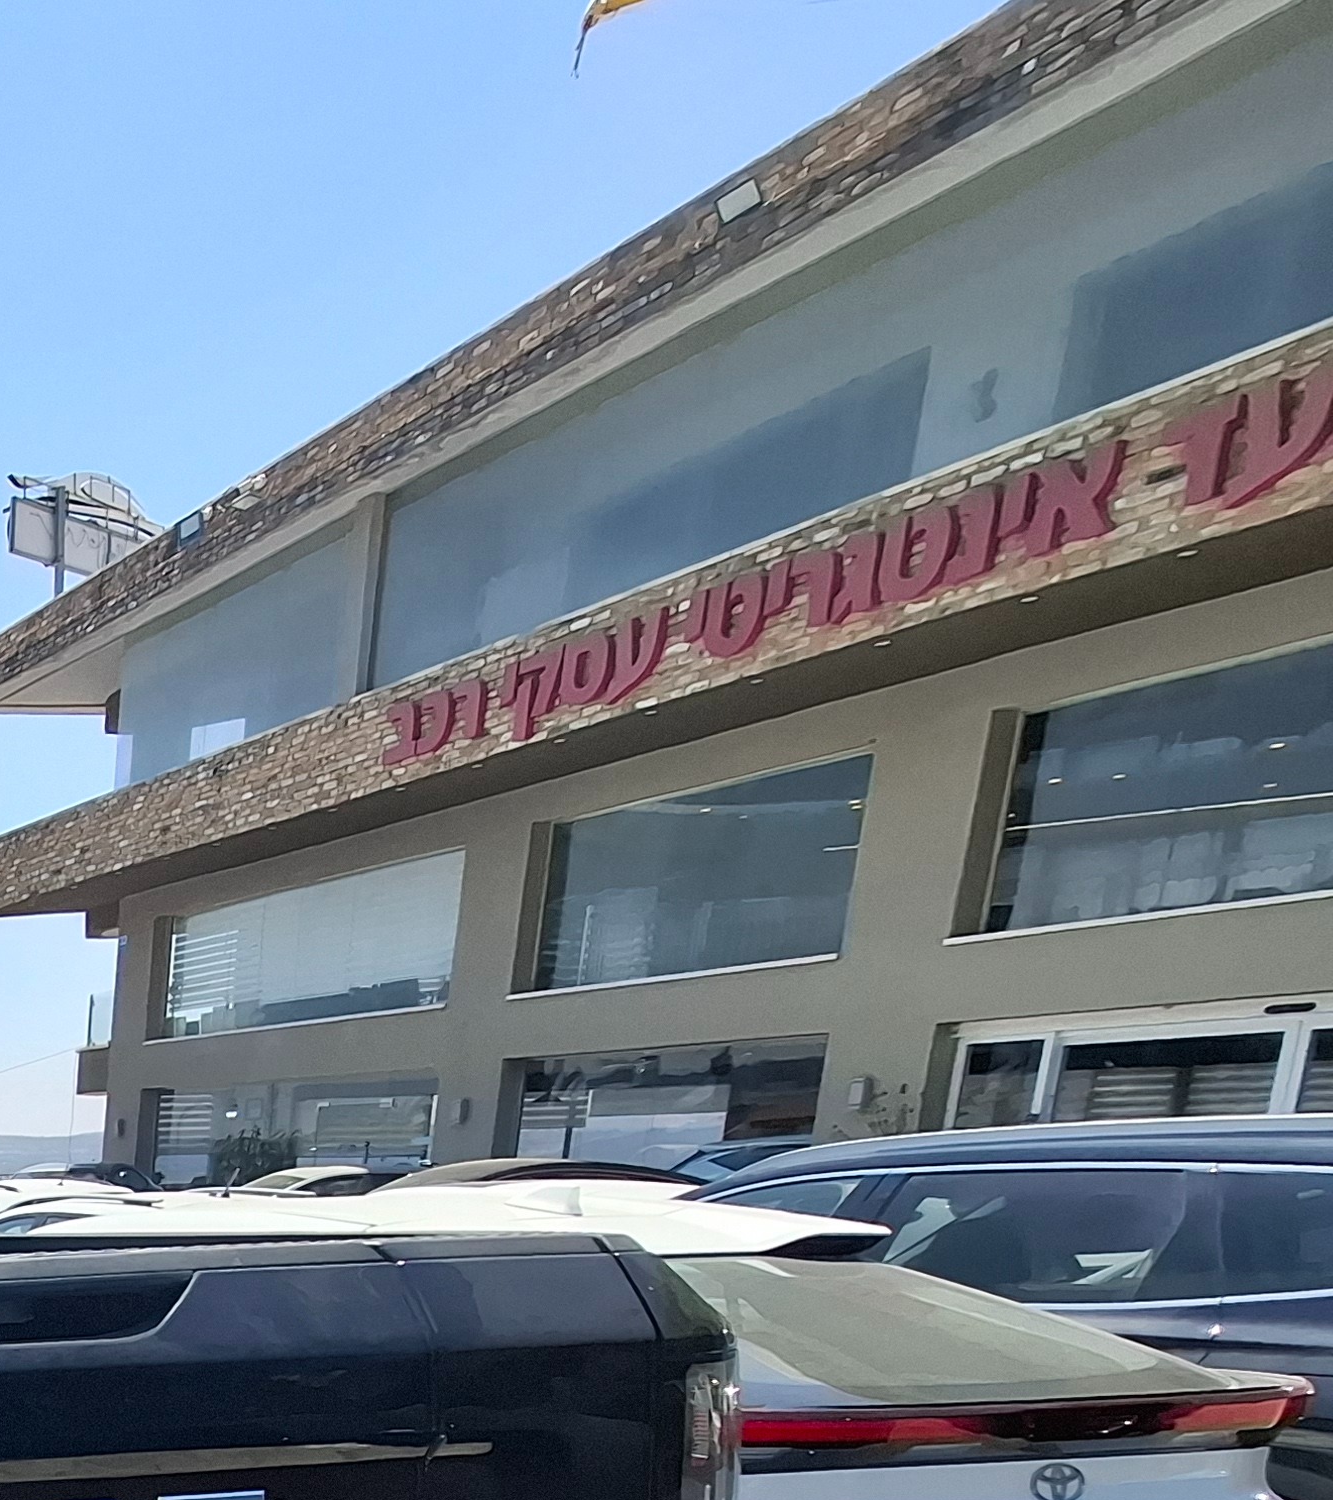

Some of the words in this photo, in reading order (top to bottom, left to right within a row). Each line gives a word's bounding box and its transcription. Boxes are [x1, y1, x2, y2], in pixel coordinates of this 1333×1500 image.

[686, 440, 1127, 657] אינטגריטי
[383, 678, 487, 766] רכב
[500, 606, 670, 742] עסקי
